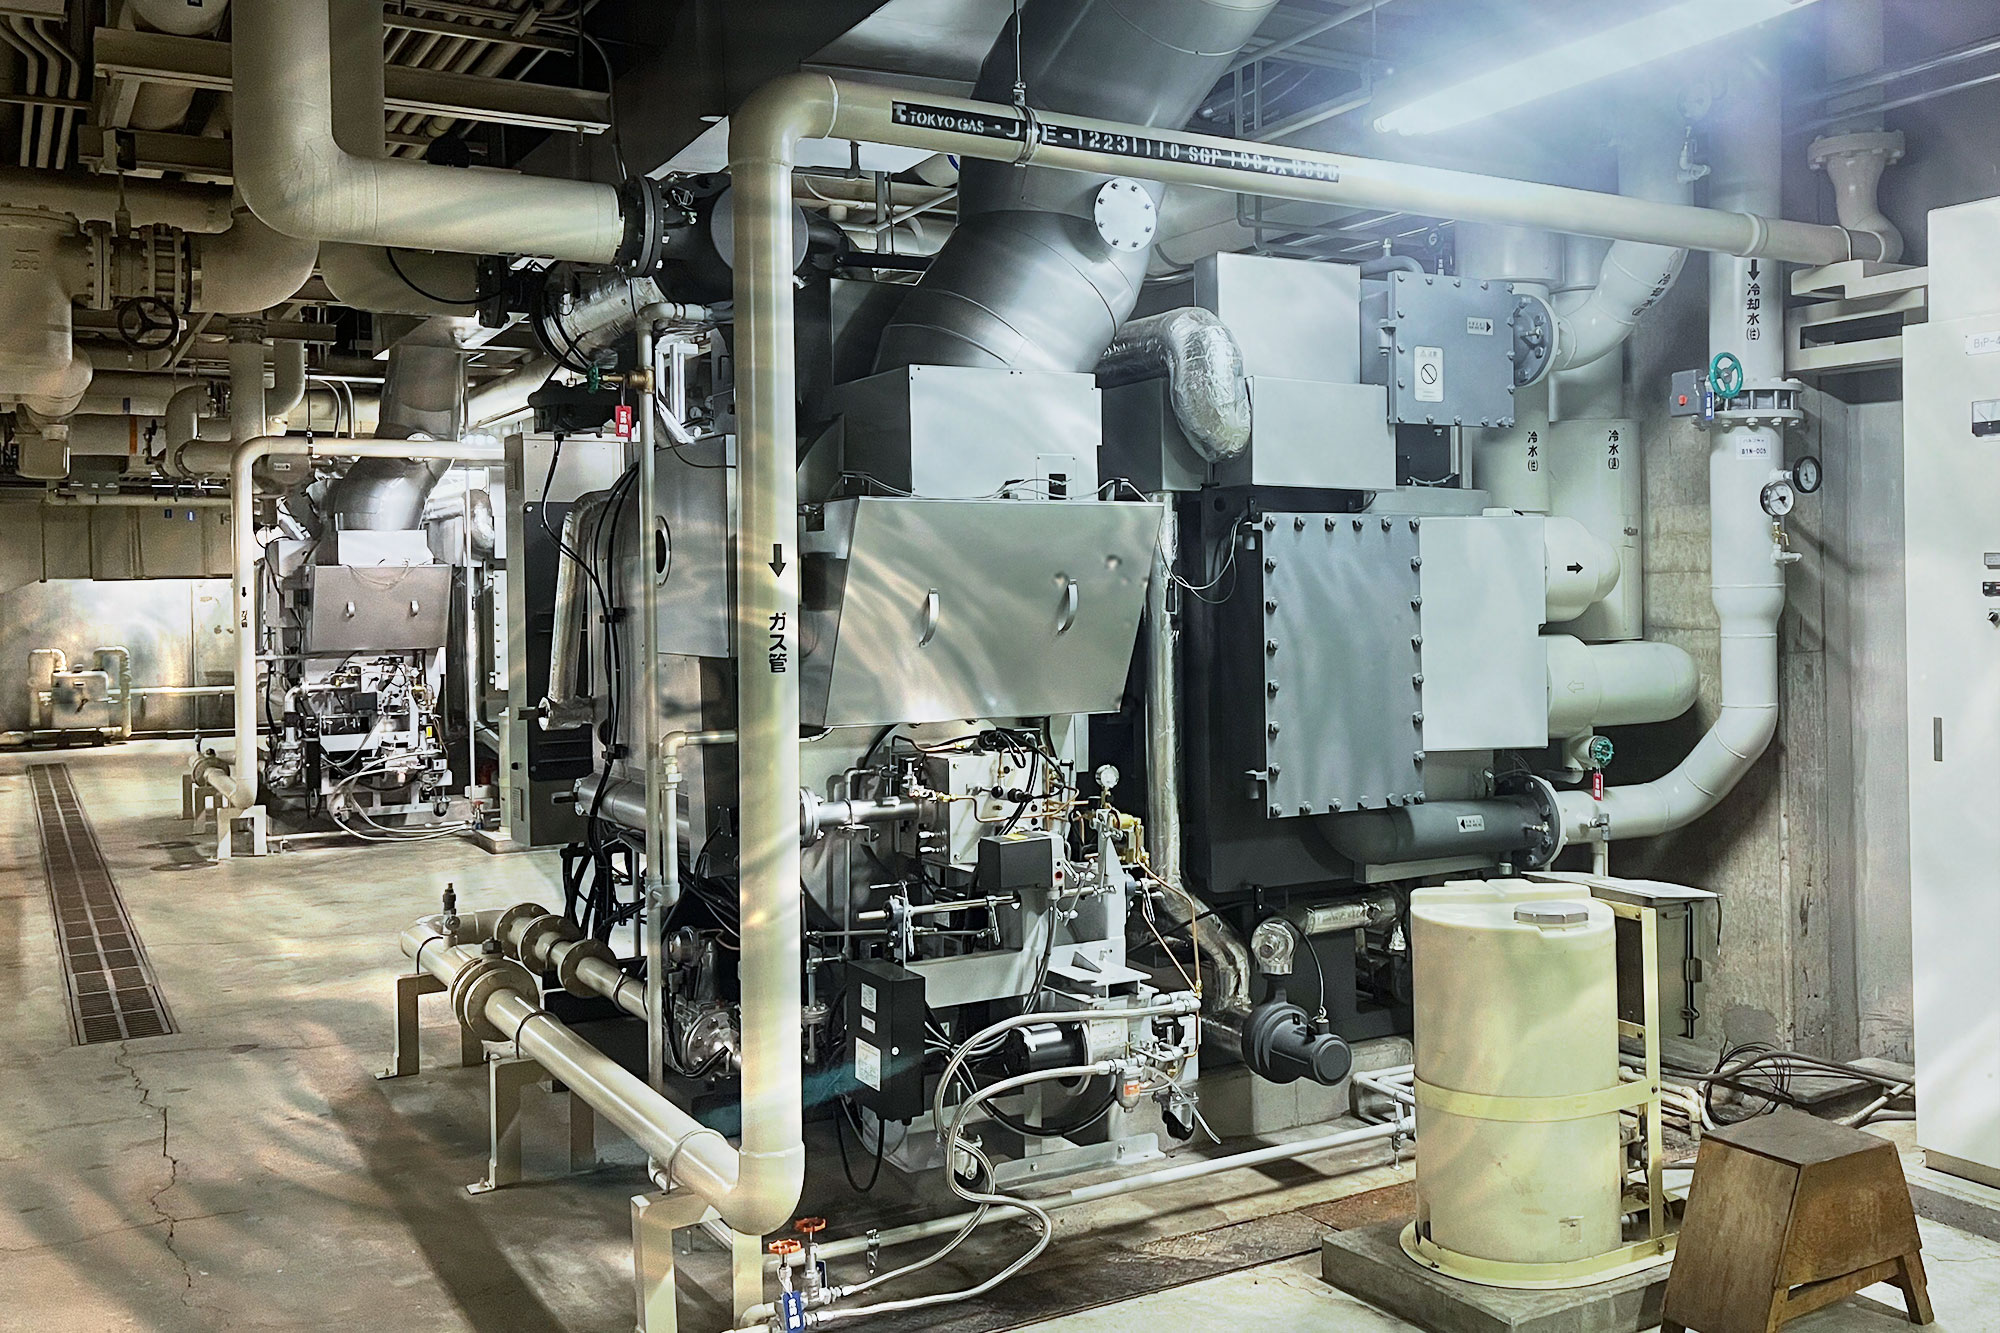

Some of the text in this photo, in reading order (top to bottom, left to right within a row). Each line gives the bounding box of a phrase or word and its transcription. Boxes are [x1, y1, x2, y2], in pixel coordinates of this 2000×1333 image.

[909, 110, 955, 129] TOKYO
[957, 118, 985, 134] GAS
[1188, 145, 1222, 166] SGP
[768, 611, 788, 673] ガス管
